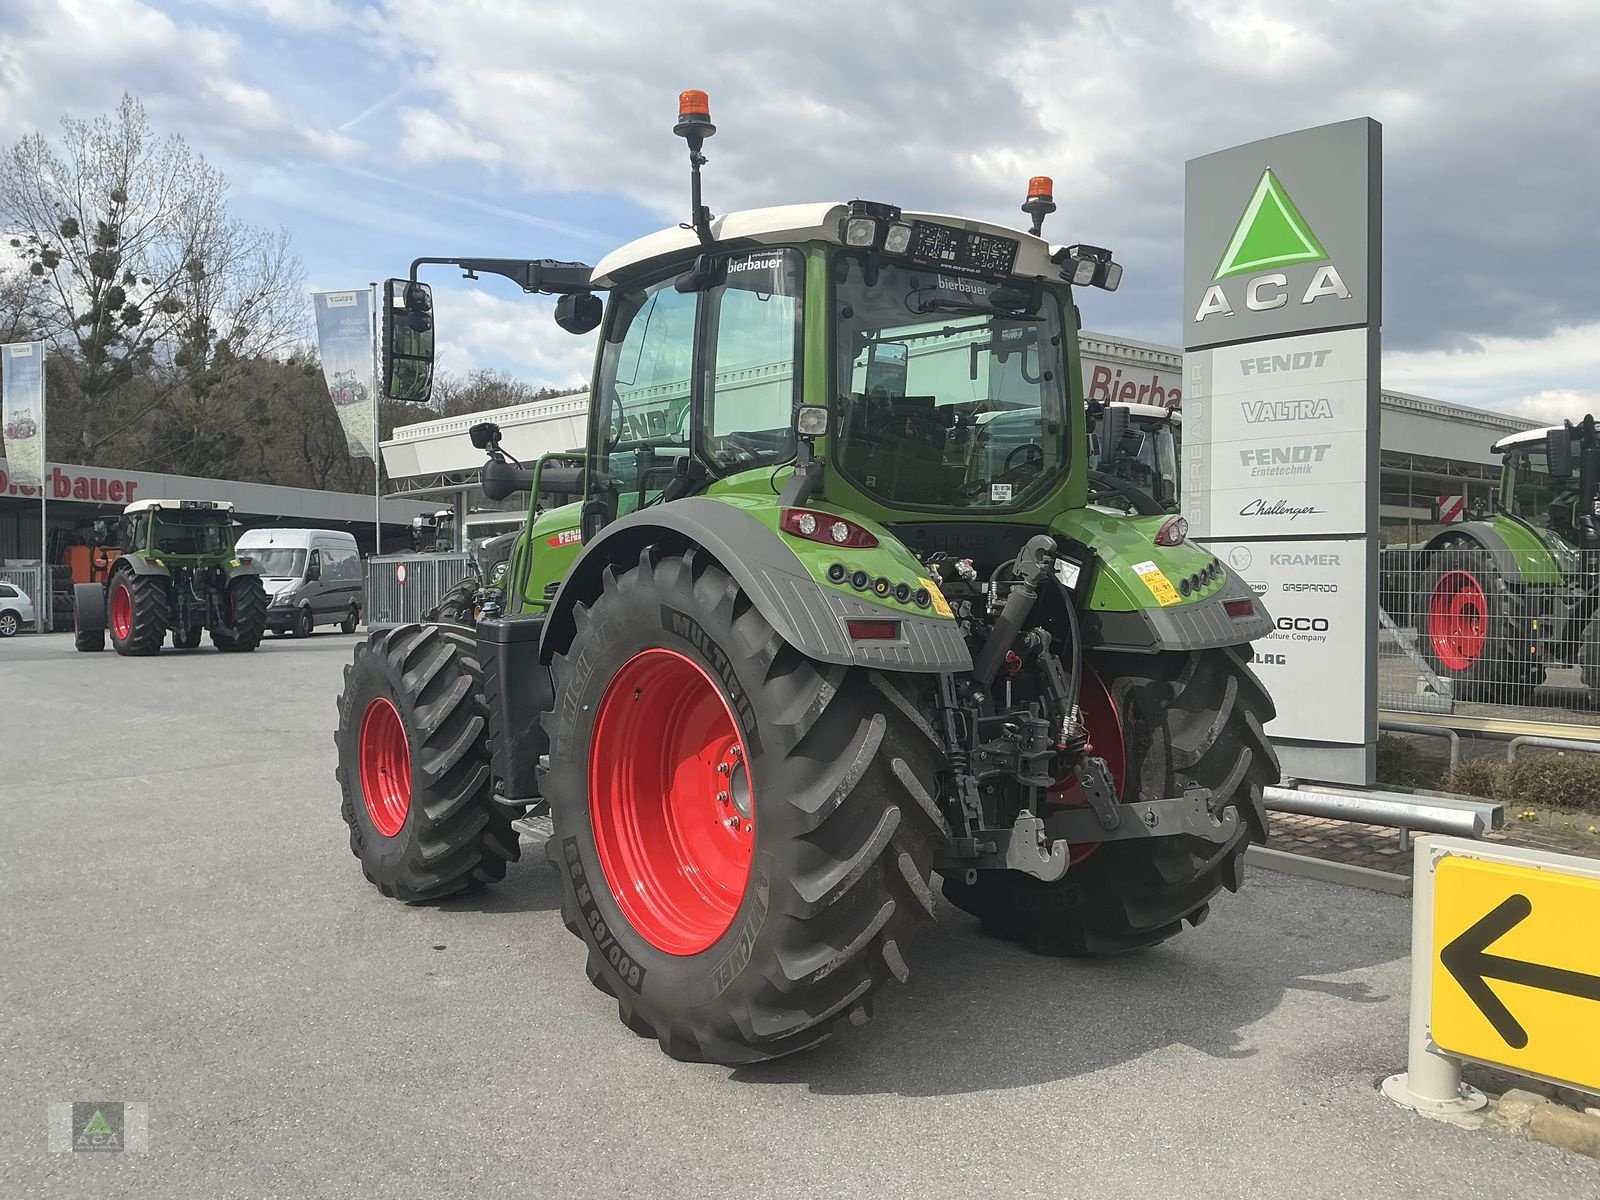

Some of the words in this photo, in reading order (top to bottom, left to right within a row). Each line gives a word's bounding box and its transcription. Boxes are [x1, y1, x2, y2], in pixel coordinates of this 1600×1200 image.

[727, 254, 782, 274] bierbauer
[937, 273, 987, 295] bierbauer
[1194, 264, 1352, 322] ACA
[1239, 349, 1333, 376] FENDT
[1241, 398, 1334, 424] VALTRA
[610, 409, 681, 441] ENDT
[1239, 444, 1332, 467] FENDT
[1250, 463, 1313, 477] Erntetechnik
[1239, 498, 1329, 521] Challenger
[1269, 553, 1341, 566] KRAMER
[1282, 583, 1338, 593] GASPARDO
[1273, 617, 1329, 632] GCO
[1291, 633, 1327, 644] Company
[586, 909, 641, 987] 600/65
